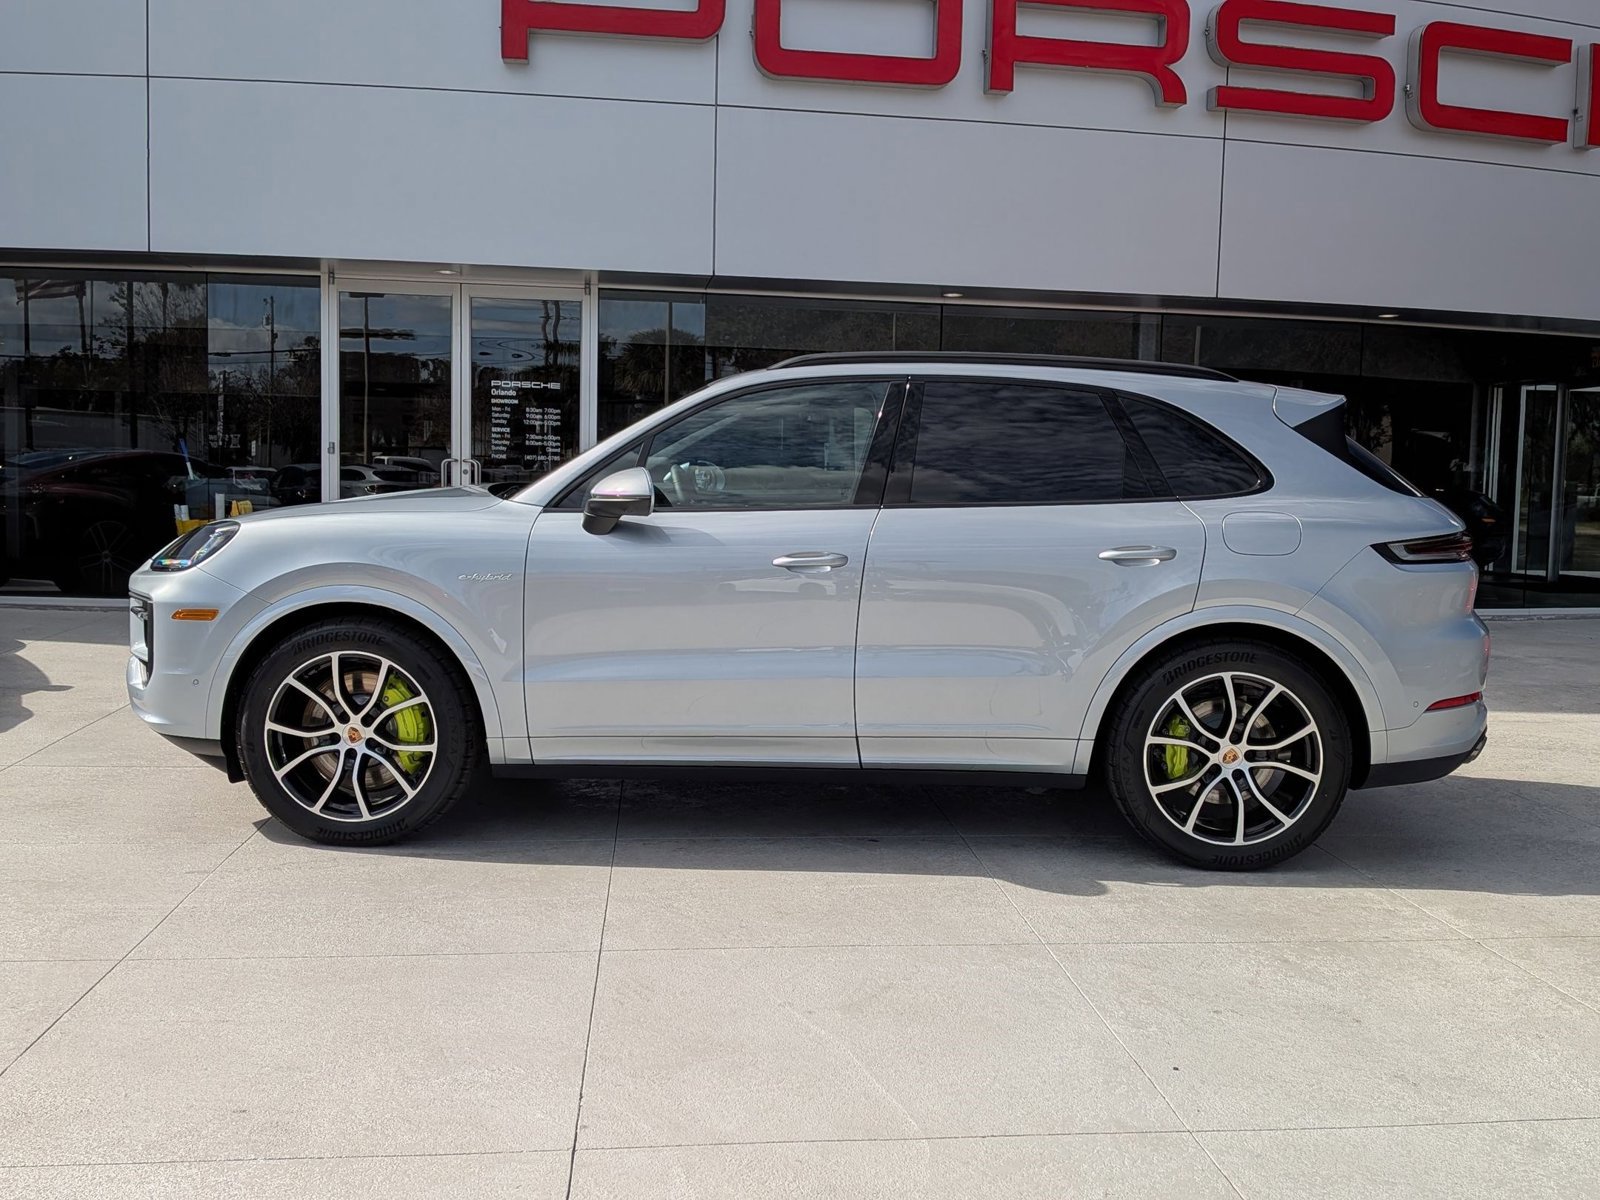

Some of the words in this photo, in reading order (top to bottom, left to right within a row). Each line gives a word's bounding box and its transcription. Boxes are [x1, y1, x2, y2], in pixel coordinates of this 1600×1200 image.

[501, 0, 1600, 147] PORSC
[491, 380, 561, 389] PORSCHE
[491, 388, 517, 396] Orlando
[292, 630, 386, 656] BRIDGESTONE
[1162, 651, 1260, 687] BRIDGESTONE
